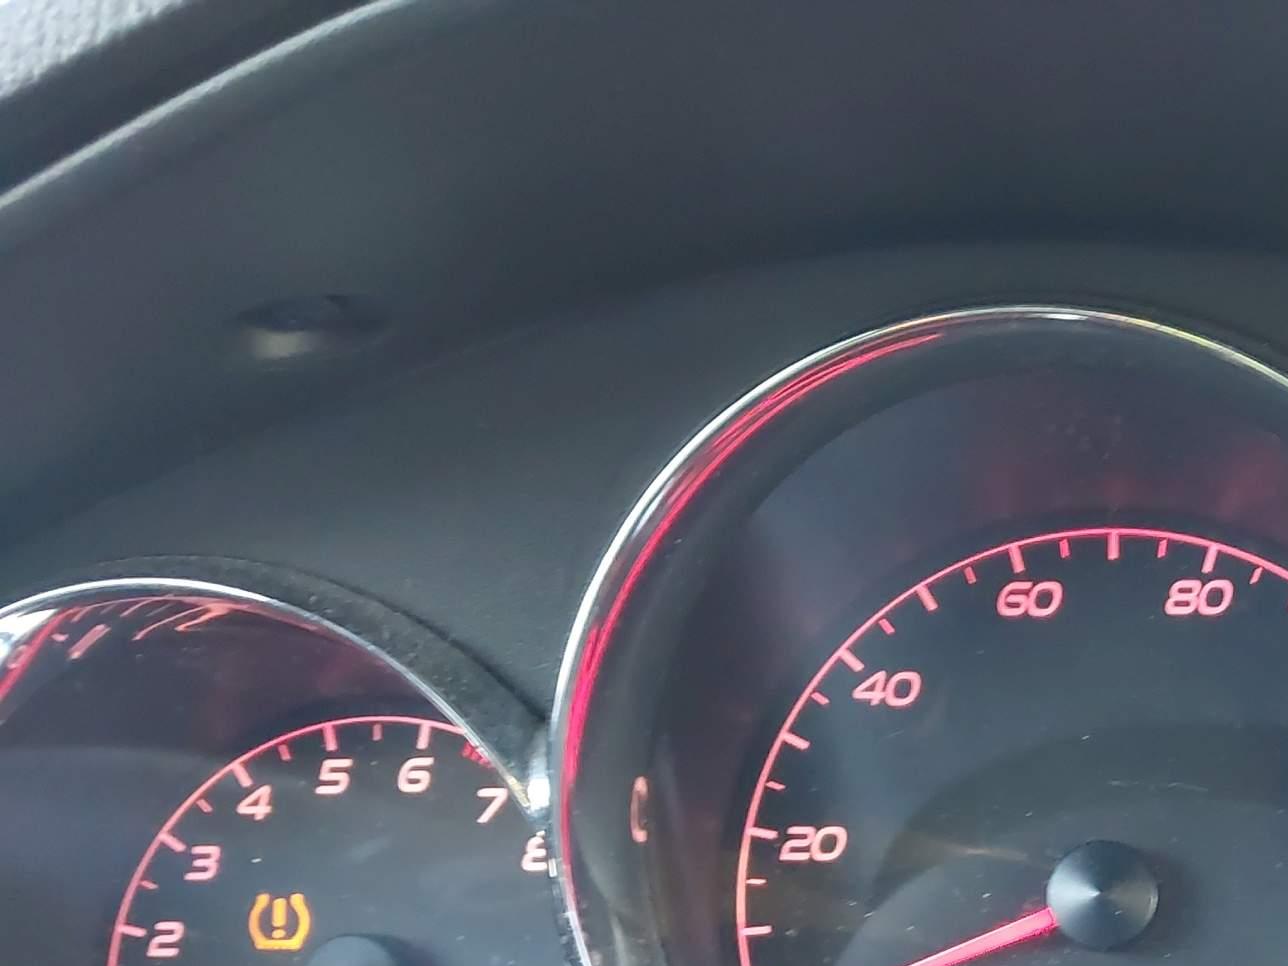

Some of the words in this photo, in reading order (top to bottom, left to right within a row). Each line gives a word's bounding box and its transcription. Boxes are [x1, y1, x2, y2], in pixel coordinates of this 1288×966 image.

[997, 582, 1063, 617] 60
[1165, 580, 1234, 615] 80
[852, 668, 921, 706] 40
[316, 758, 352, 794] 5
[397, 757, 434, 792] 6
[237, 784, 272, 820] 4
[477, 788, 508, 824] 7
[780, 826, 847, 861] 20
[183, 845, 221, 880] 3
[147, 922, 184, 957] 2
